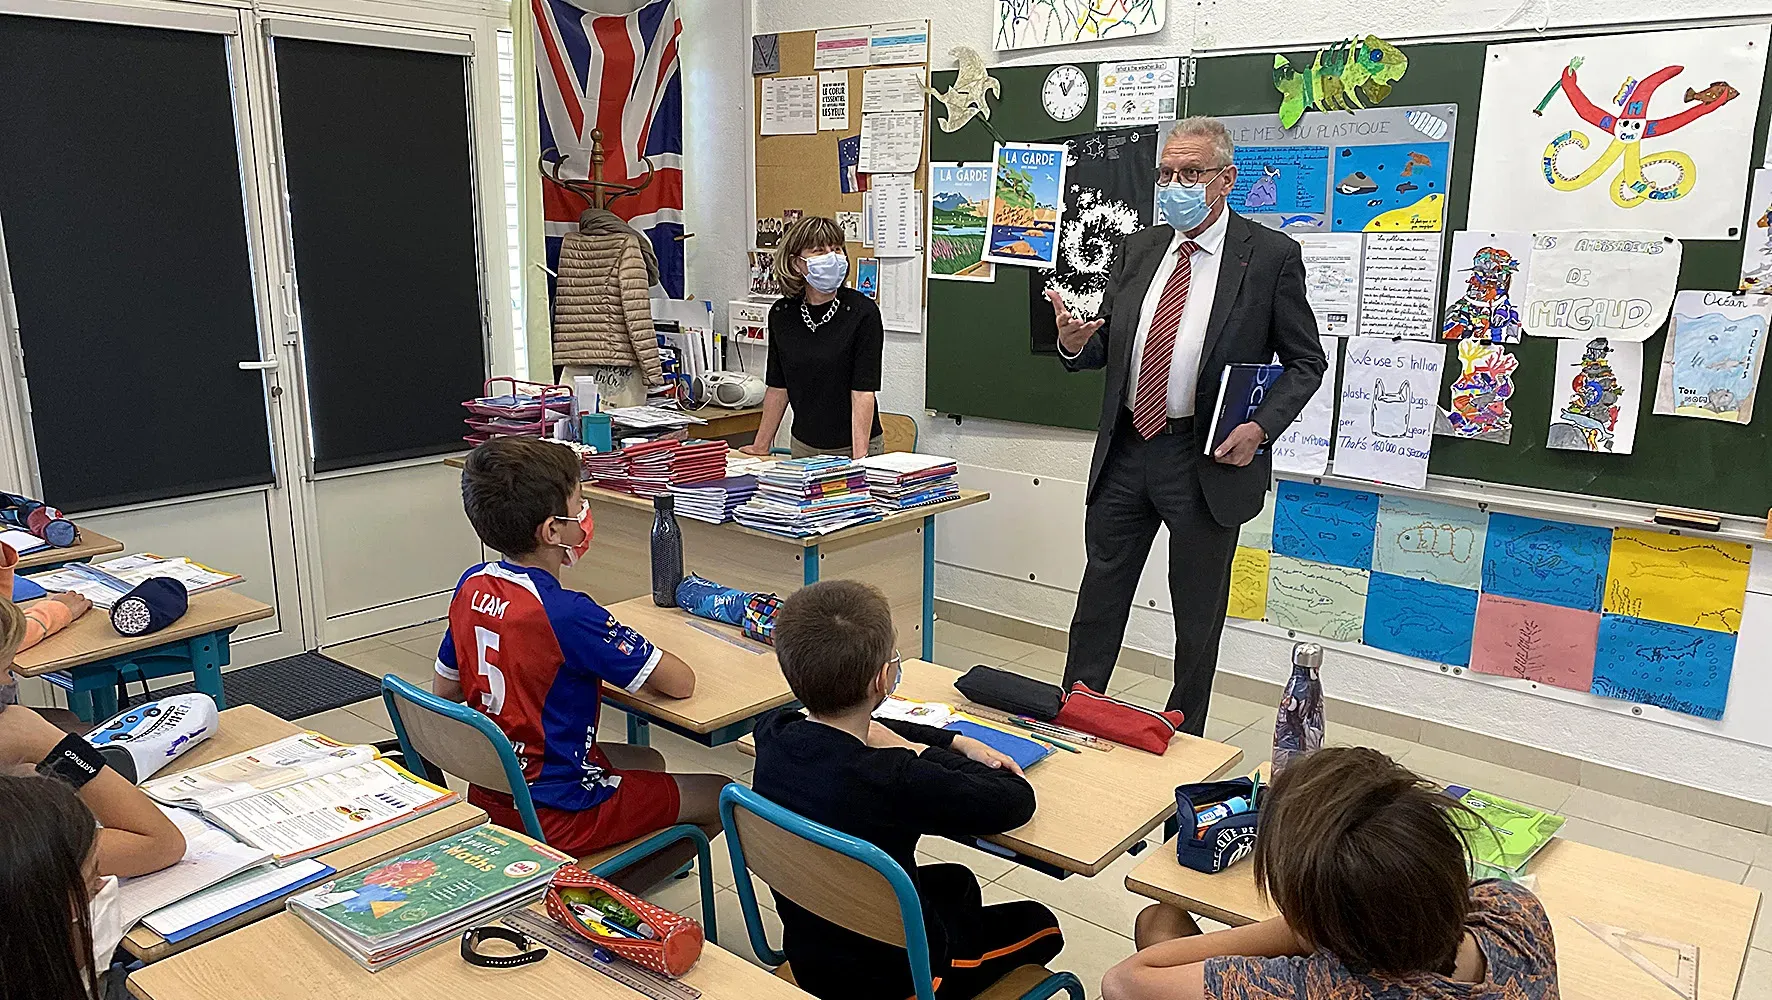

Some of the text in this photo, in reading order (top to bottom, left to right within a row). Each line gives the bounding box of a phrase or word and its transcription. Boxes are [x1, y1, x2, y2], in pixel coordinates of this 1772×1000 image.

[829, 87, 846, 96] COEUR
[822, 108, 845, 116] LES YEUX
[1294, 125, 1312, 140] DU
[1316, 121, 1391, 138] PLASTIQUE
[1005, 152, 1056, 166] LA GARDE
[940, 169, 988, 182] LA GARDE
[1533, 236, 1558, 250] LES
[1566, 268, 1592, 287] DE
[1703, 292, 1748, 309] Océan
[1346, 350, 1438, 372] We use 5 trillion
[1342, 384, 1429, 410] plastic bags
[1340, 419, 1354, 432] per
[1408, 423, 1431, 438] year!
[1339, 435, 1368, 450] That's
[1398, 446, 1406, 456] a
[470, 590, 512, 620] LIAM
[474, 626, 506, 716] 5
[64, 748, 97, 776] ARTENGO
[463, 840, 502, 857] portée
[443, 845, 496, 872] Maths
